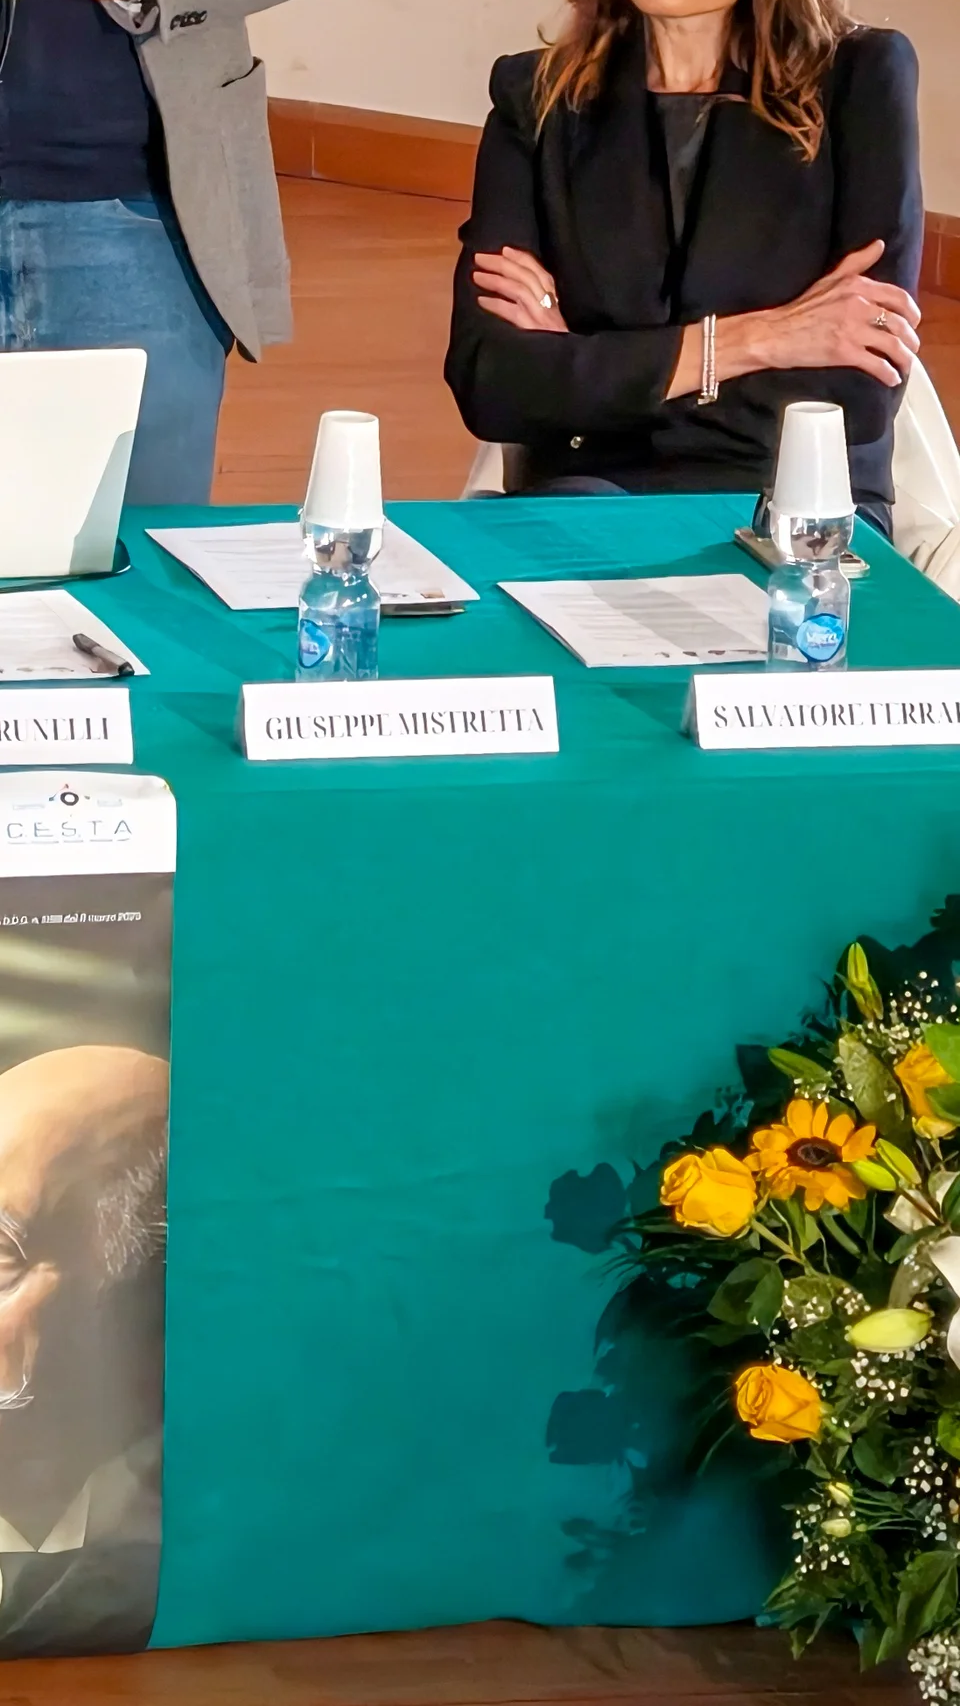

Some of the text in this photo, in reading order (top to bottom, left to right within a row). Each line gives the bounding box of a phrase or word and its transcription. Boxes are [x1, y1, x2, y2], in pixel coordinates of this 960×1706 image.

[265, 707, 544, 741] GIUSEPPE MISTRETTA
[714, 701, 960, 728] SALVATORE FERRA
